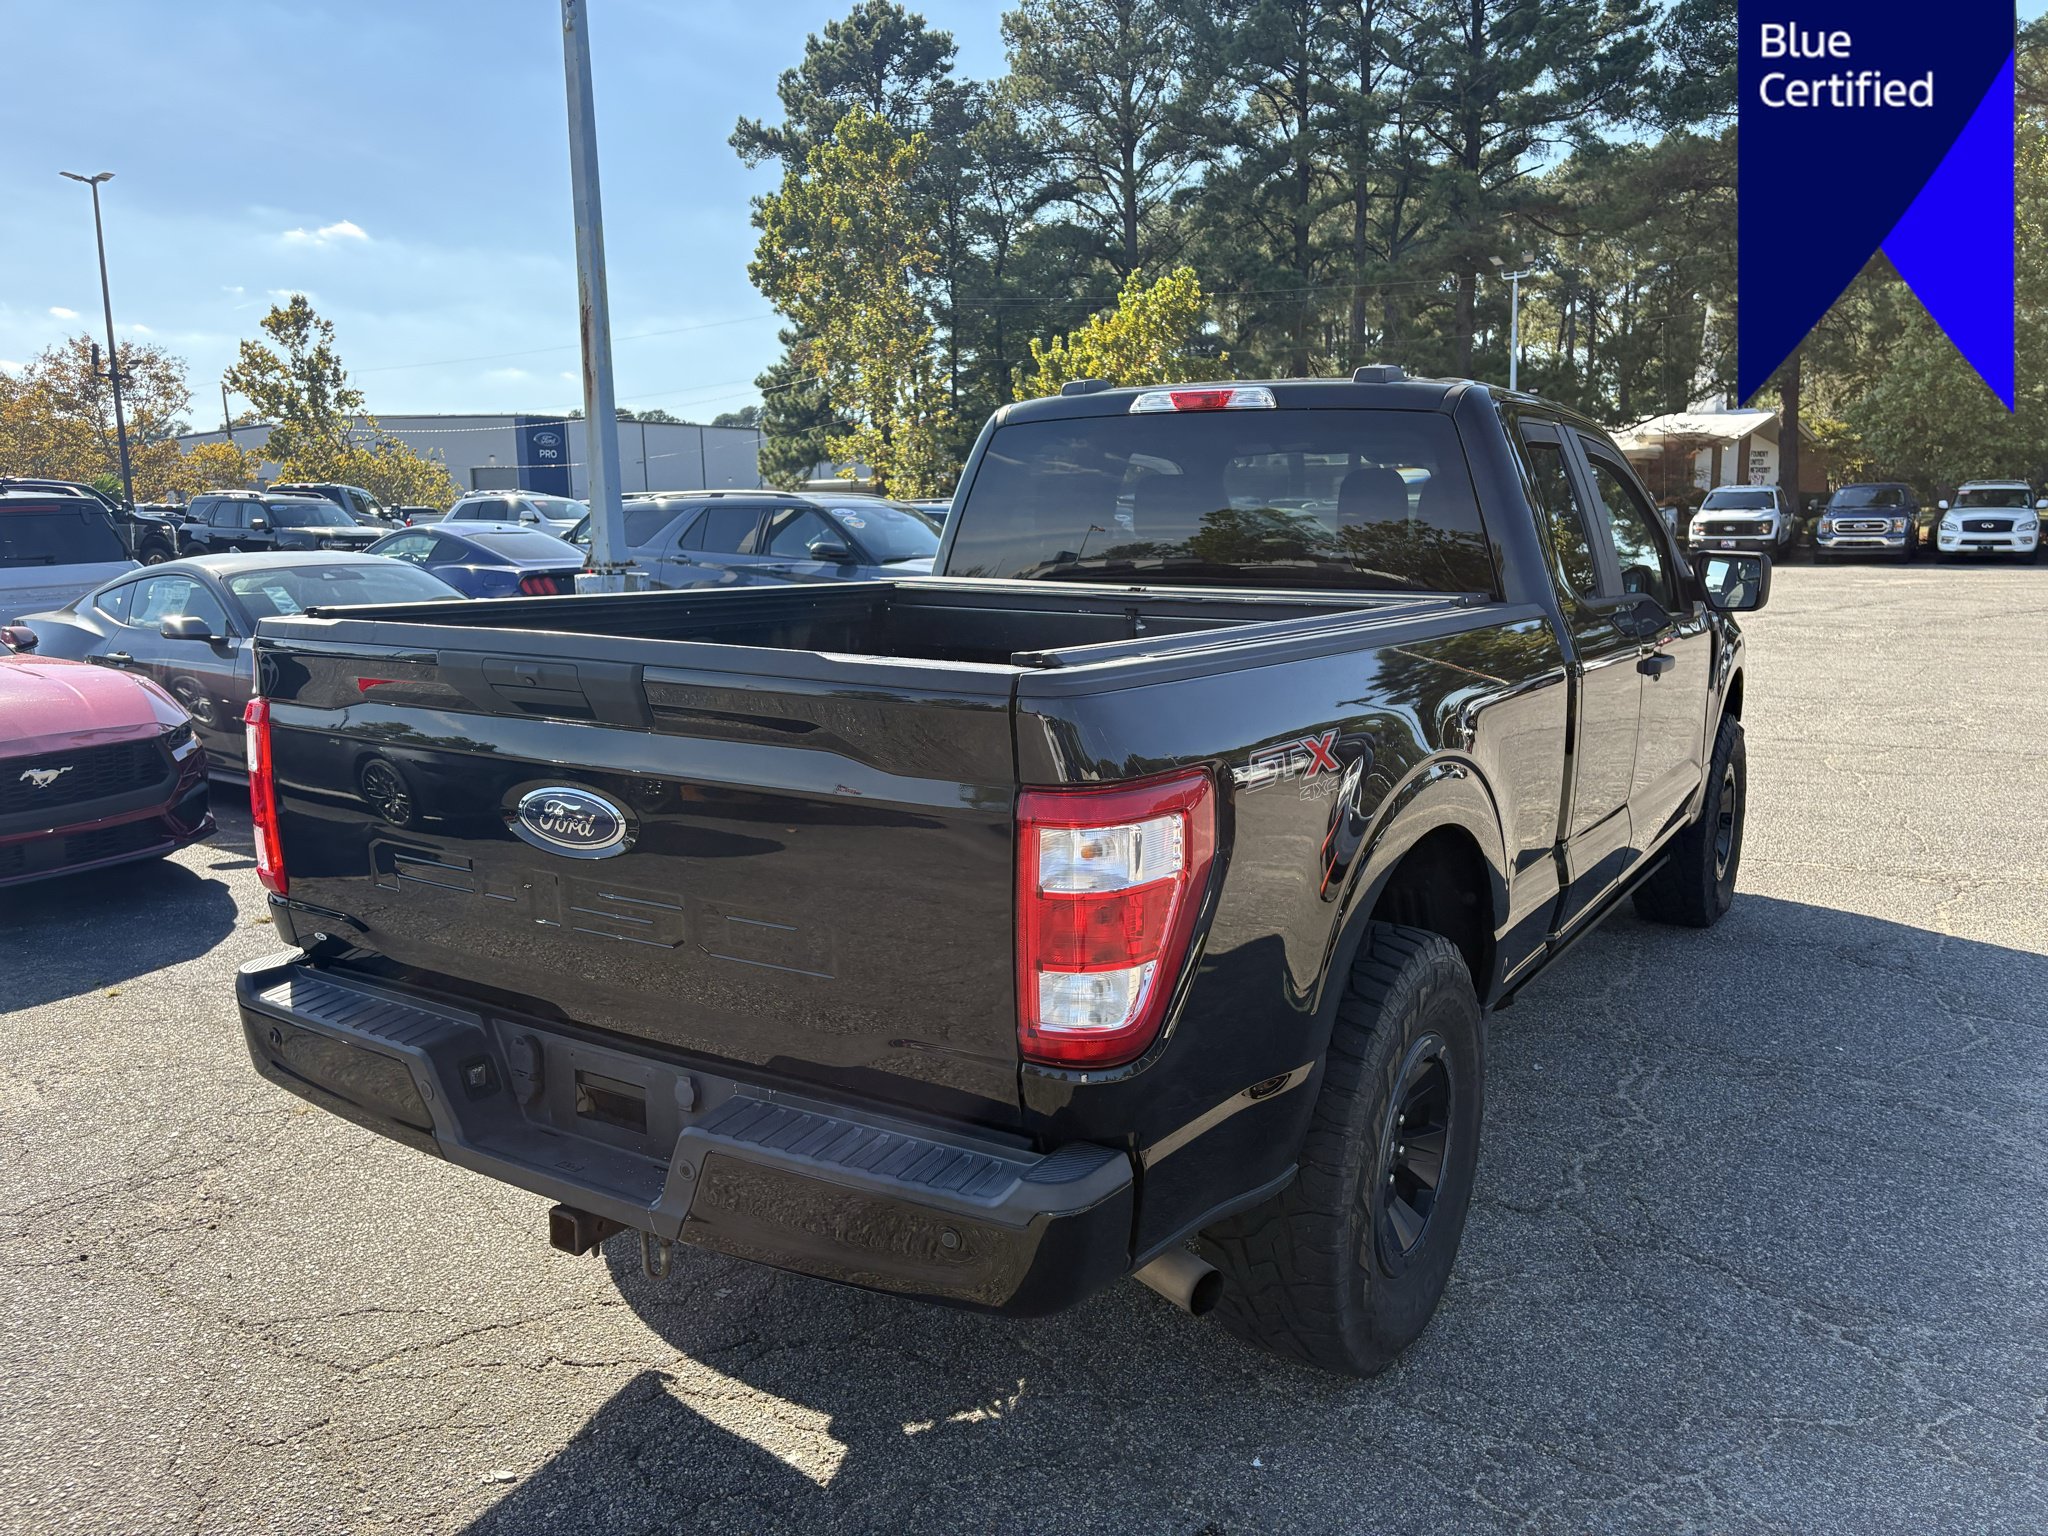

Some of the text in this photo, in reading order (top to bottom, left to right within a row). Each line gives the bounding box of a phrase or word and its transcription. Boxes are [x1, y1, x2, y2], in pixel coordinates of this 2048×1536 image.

[539, 449, 558, 459] PRO
[1246, 728, 1345, 795] STX
[539, 799, 596, 837] Ford
